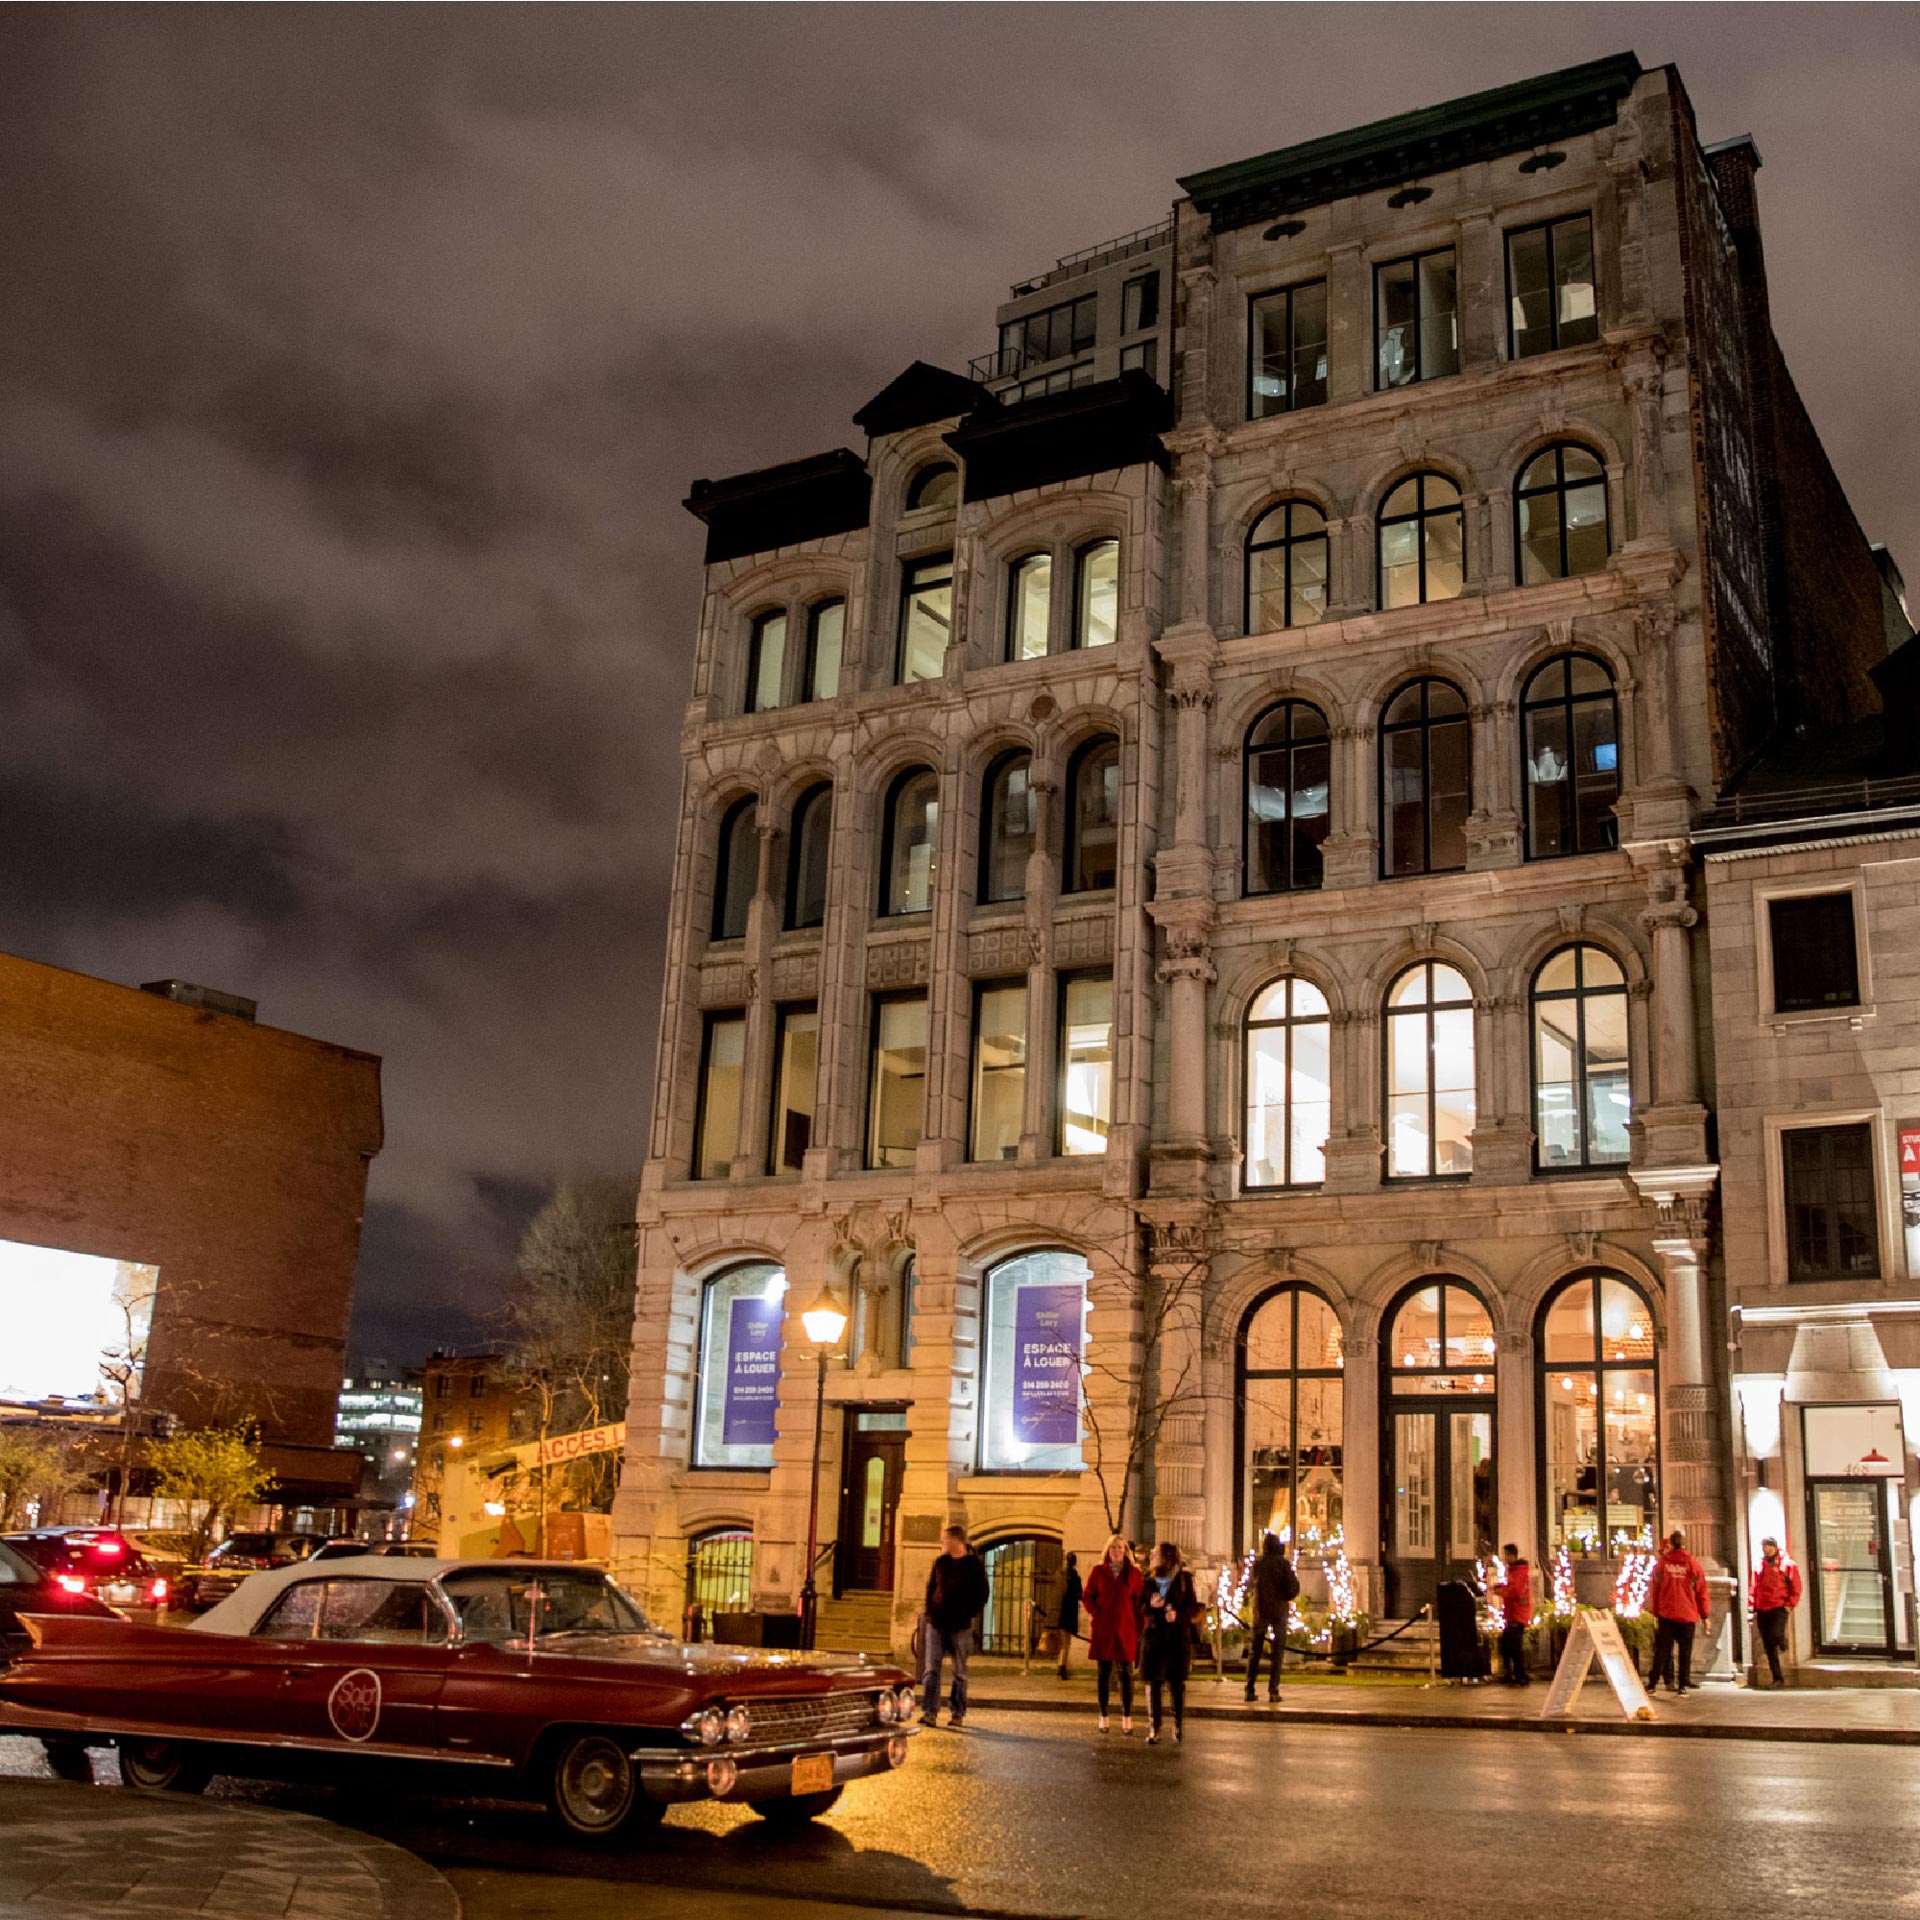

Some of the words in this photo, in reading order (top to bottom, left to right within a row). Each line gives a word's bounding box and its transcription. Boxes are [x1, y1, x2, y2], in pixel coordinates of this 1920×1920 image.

[1904, 1144, 1916, 1162] À
[1023, 1343, 1072, 1355] ESPACE
[735, 1351, 777, 1362] ESPACE
[1023, 1355, 1032, 1368] À
[1034, 1356, 1071, 1368] LOUER
[734, 1361, 743, 1374] À
[744, 1363, 776, 1374] LOUER
[536, 1430, 606, 1463] ACCES
